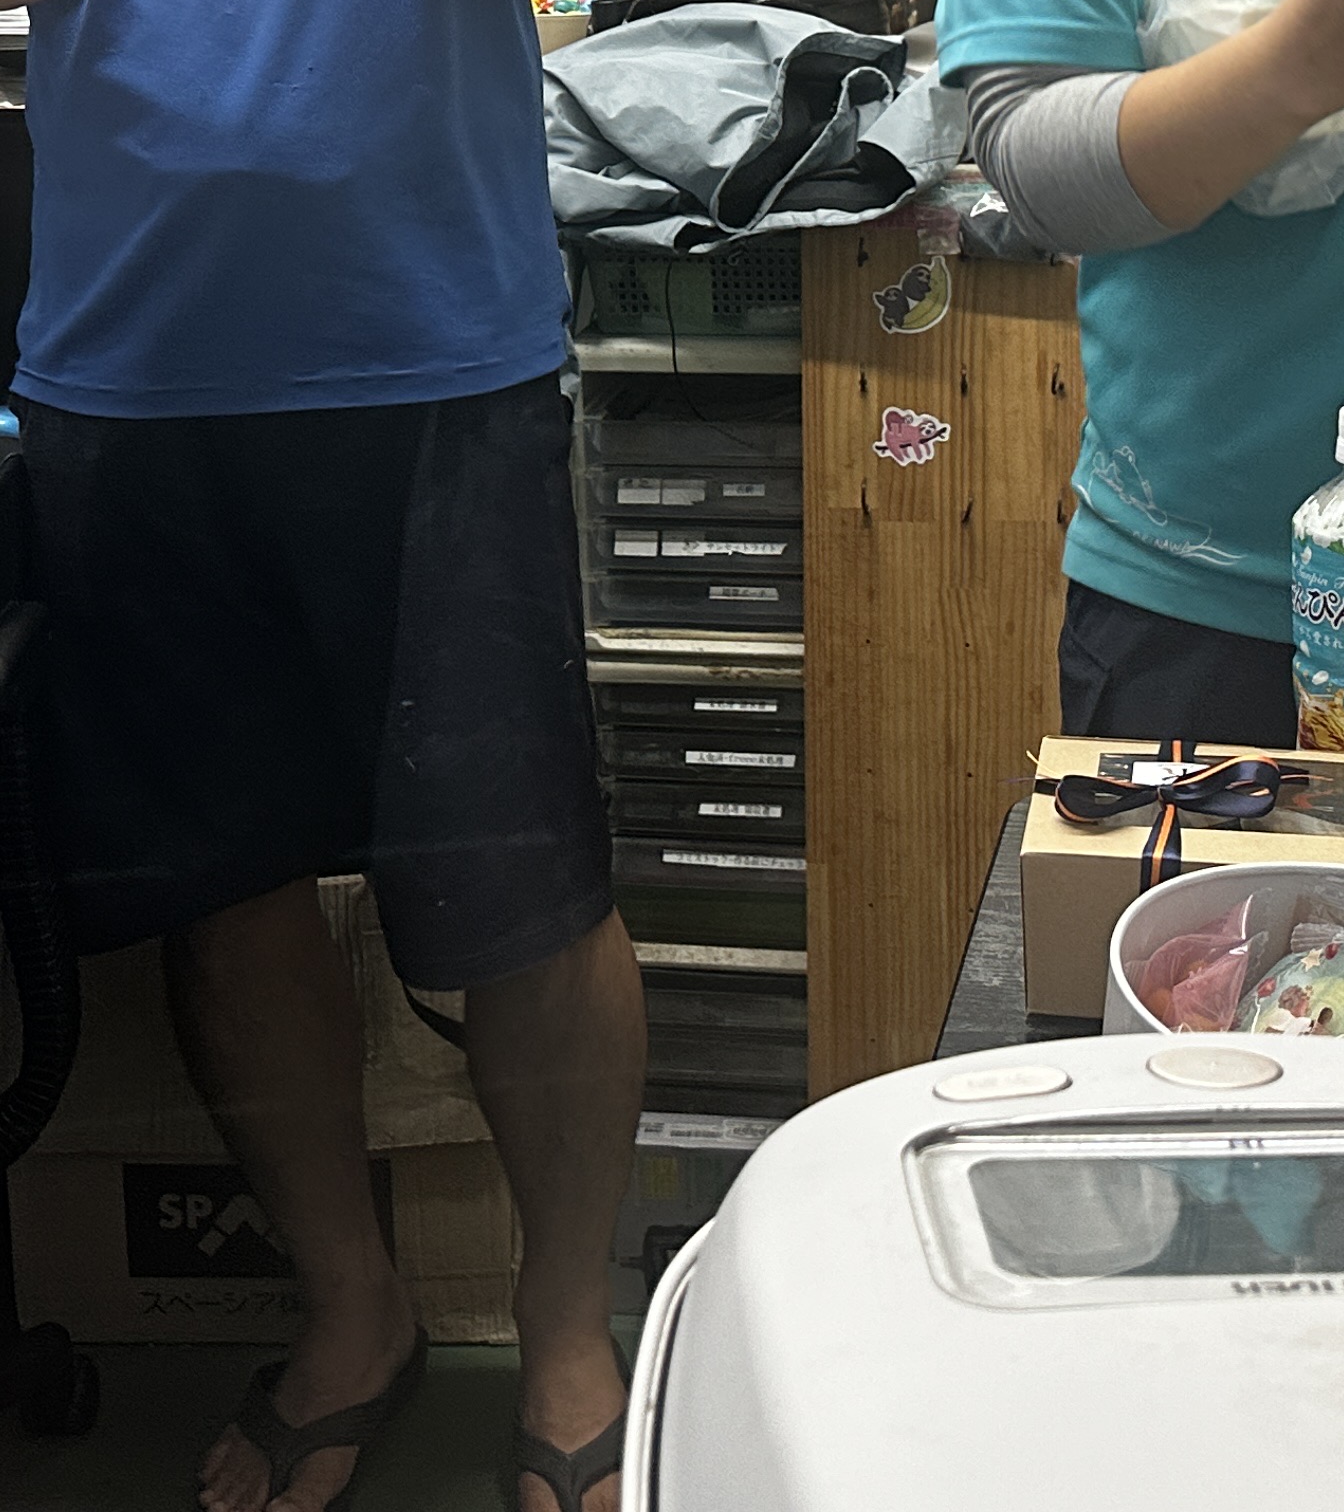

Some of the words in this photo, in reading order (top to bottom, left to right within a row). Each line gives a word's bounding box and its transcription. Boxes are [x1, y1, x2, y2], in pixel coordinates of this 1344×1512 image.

[137, 1291, 296, 1317] スペーシア
